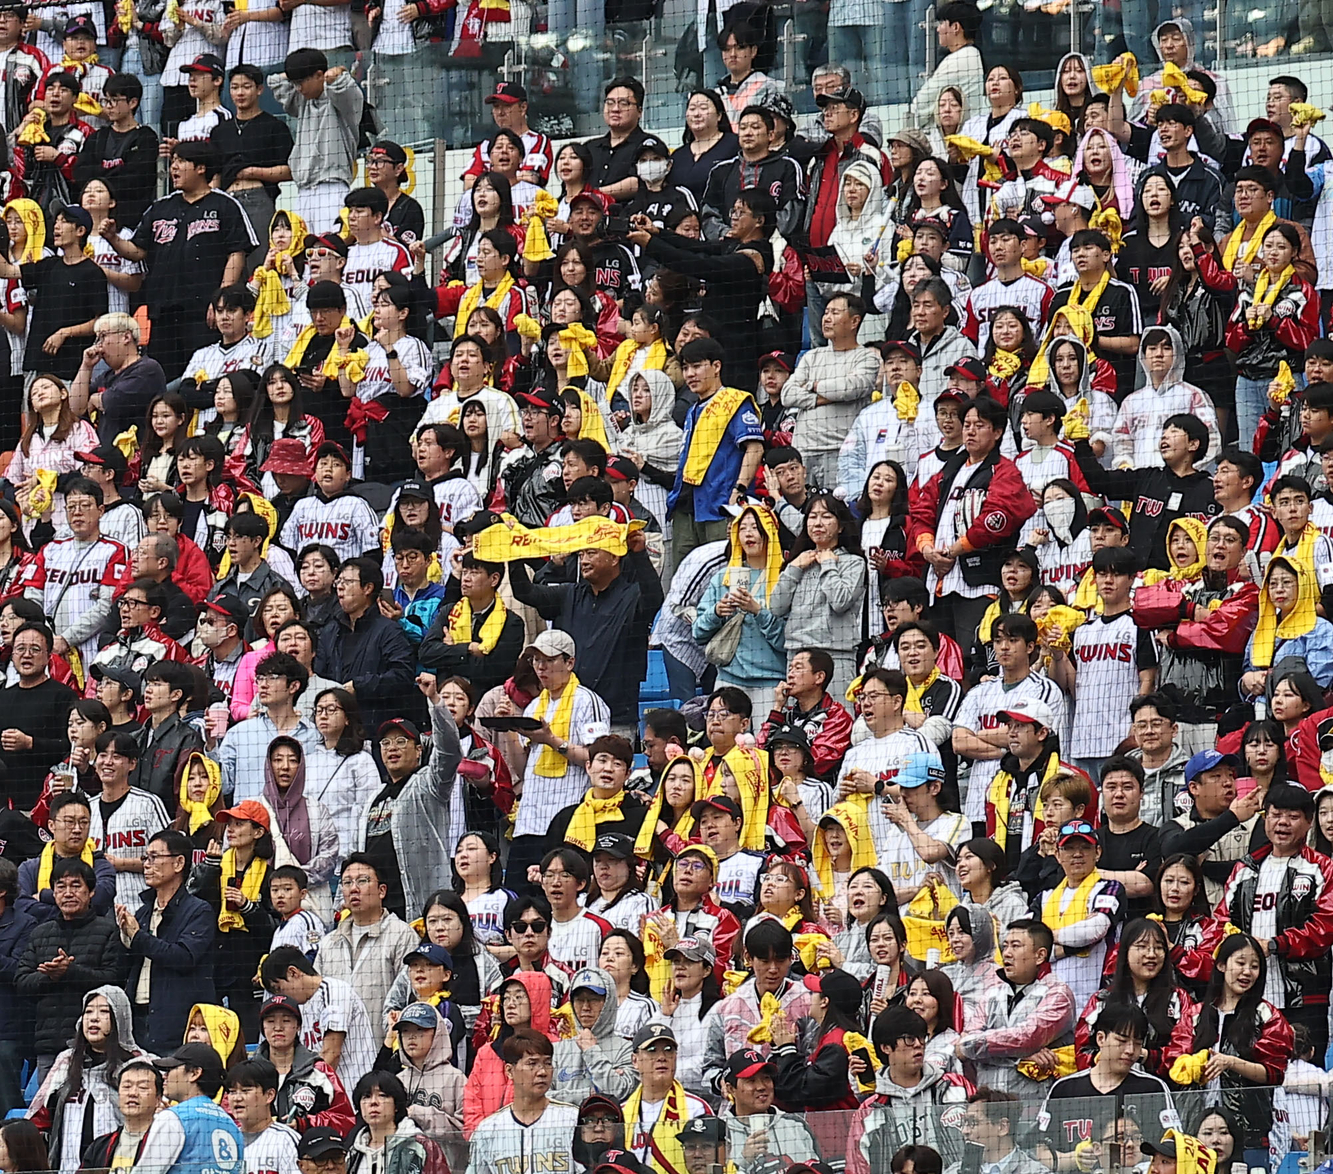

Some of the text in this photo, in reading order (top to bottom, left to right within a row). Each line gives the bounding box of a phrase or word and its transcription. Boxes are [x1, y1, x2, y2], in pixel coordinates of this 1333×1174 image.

[203, 210, 217, 220] LG
[606, 259, 621, 269] LG
[1097, 305, 1110, 316] LG
[299, 521, 353, 541] TWINS
[1116, 629, 1132, 640] LG
[728, 869, 744, 879] LG
[483, 902, 499, 912] LG
[572, 947, 588, 958] LG
[256, 1157, 273, 1167] LG
[494, 1150, 569, 1174] TWINS
